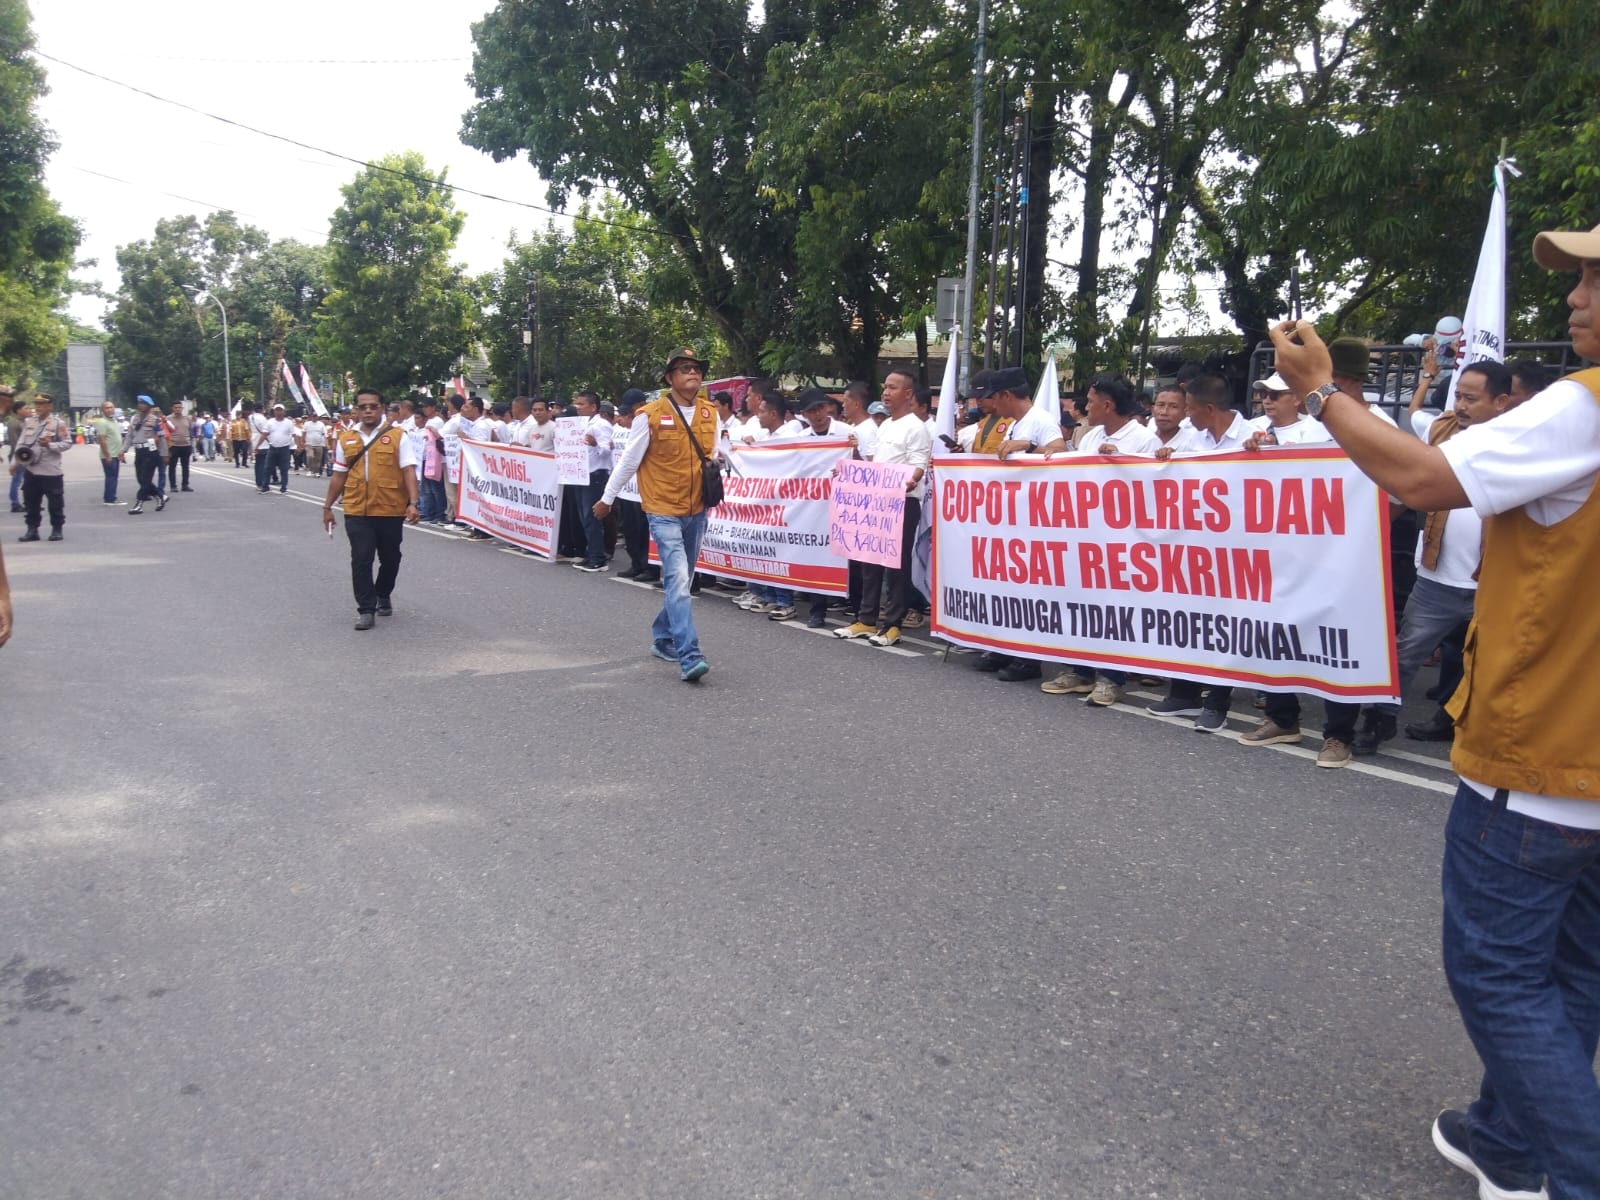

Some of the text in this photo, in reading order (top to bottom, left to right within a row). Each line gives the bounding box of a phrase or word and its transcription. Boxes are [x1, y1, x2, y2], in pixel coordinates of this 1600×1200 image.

[519, 487, 542, 509] Tahun
[943, 479, 1022, 526] COPOT
[1028, 478, 1231, 533] KAPOLRES
[1243, 477, 1346, 536] DAN
[730, 526, 763, 543] BIARKAN
[762, 533, 787, 545] KAMI
[738, 544, 777, 559] NYAMAN
[971, 535, 1273, 604] KASAT RESKRIM
[943, 586, 989, 625] KARENA
[991, 594, 1064, 635] DIDUGA
[1066, 601, 1136, 643] TIDAK
